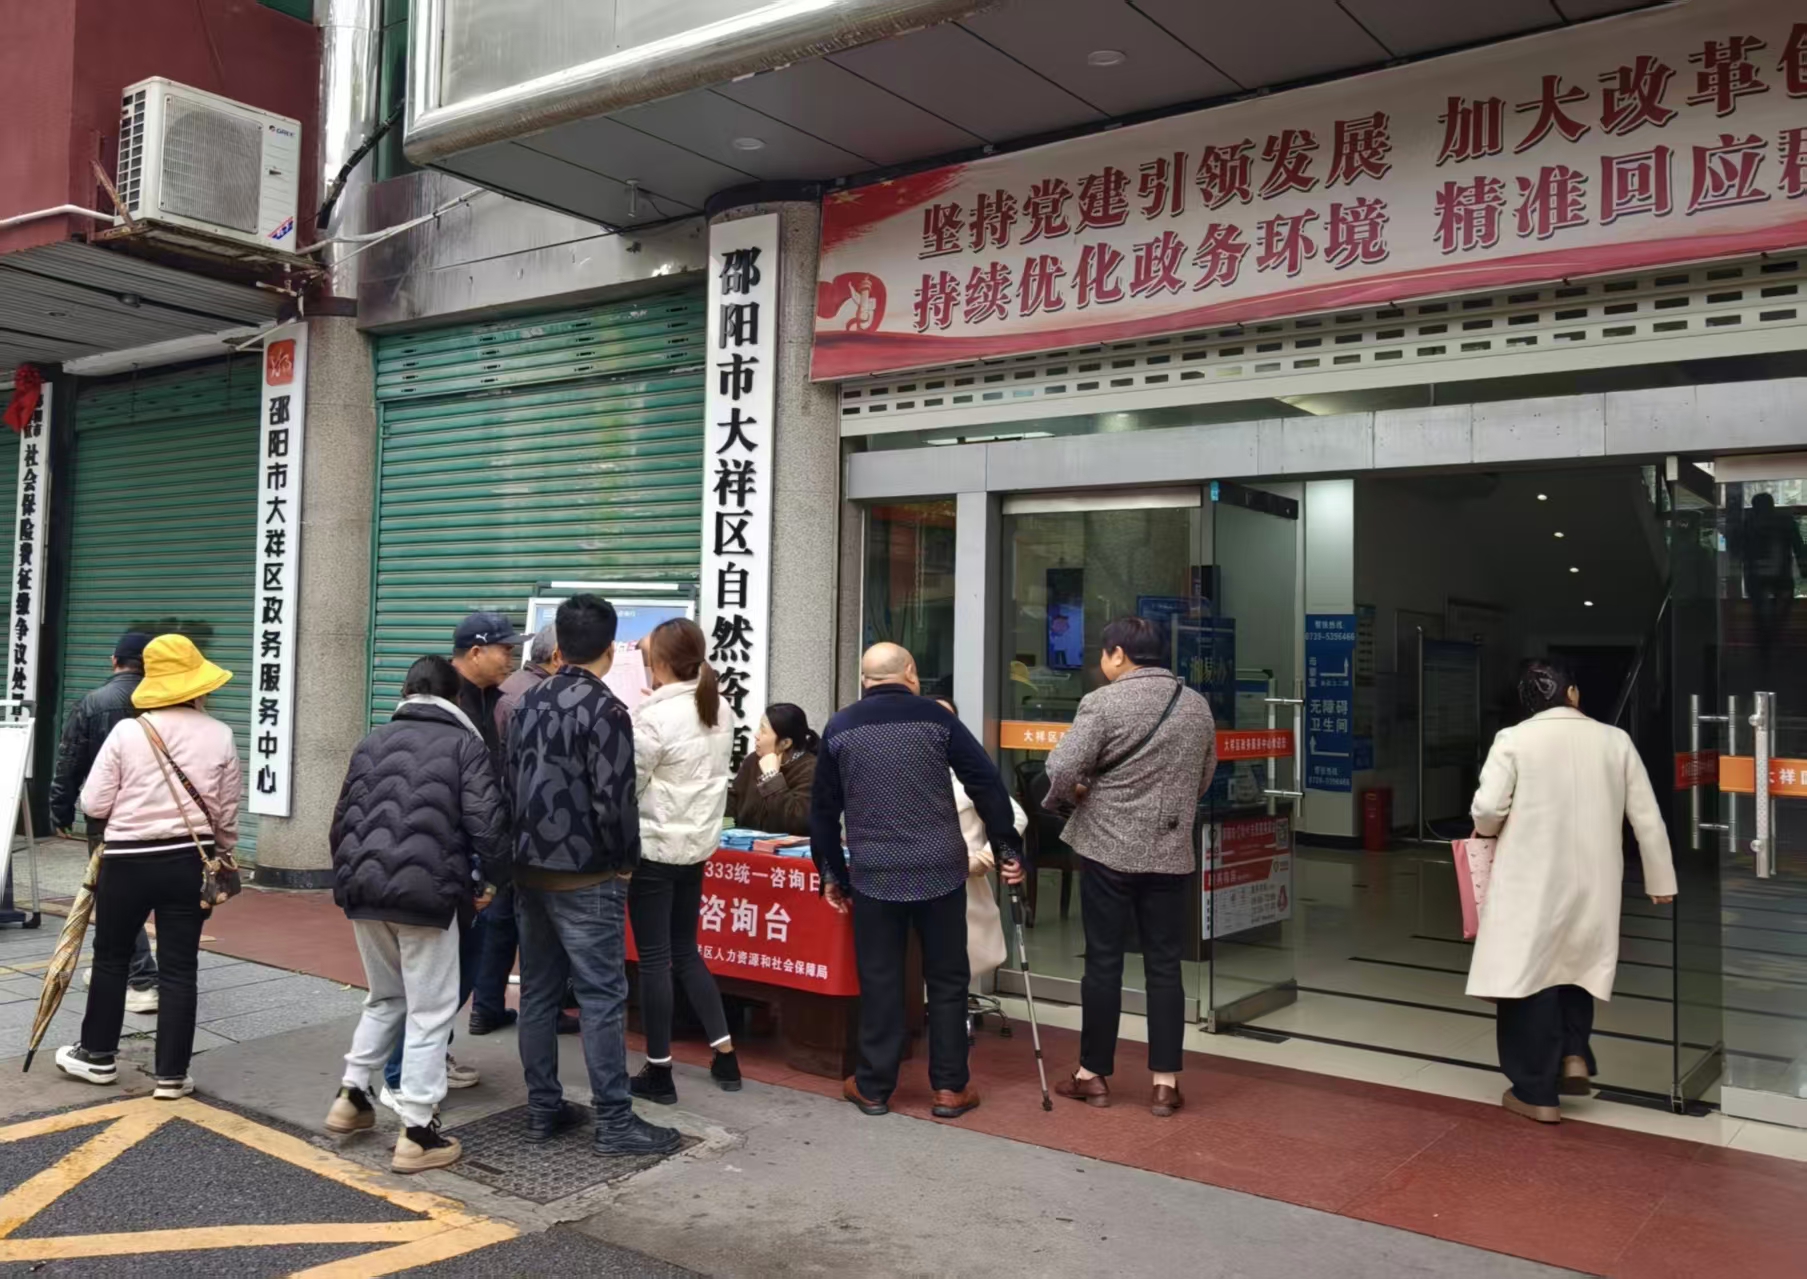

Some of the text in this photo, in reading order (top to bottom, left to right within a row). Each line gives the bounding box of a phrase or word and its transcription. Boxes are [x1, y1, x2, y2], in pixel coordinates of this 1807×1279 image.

[917, 110, 1392, 260] 坚持党建引领发展
[912, 196, 1388, 332] 持续优化政务环境
[257, 394, 291, 795] 邵阳市大祥区政务服务中心
[1309, 717, 1348, 733] 卫生间
[699, 893, 791, 943] 咨询台
[704, 860, 821, 893] 333统一咨询日
